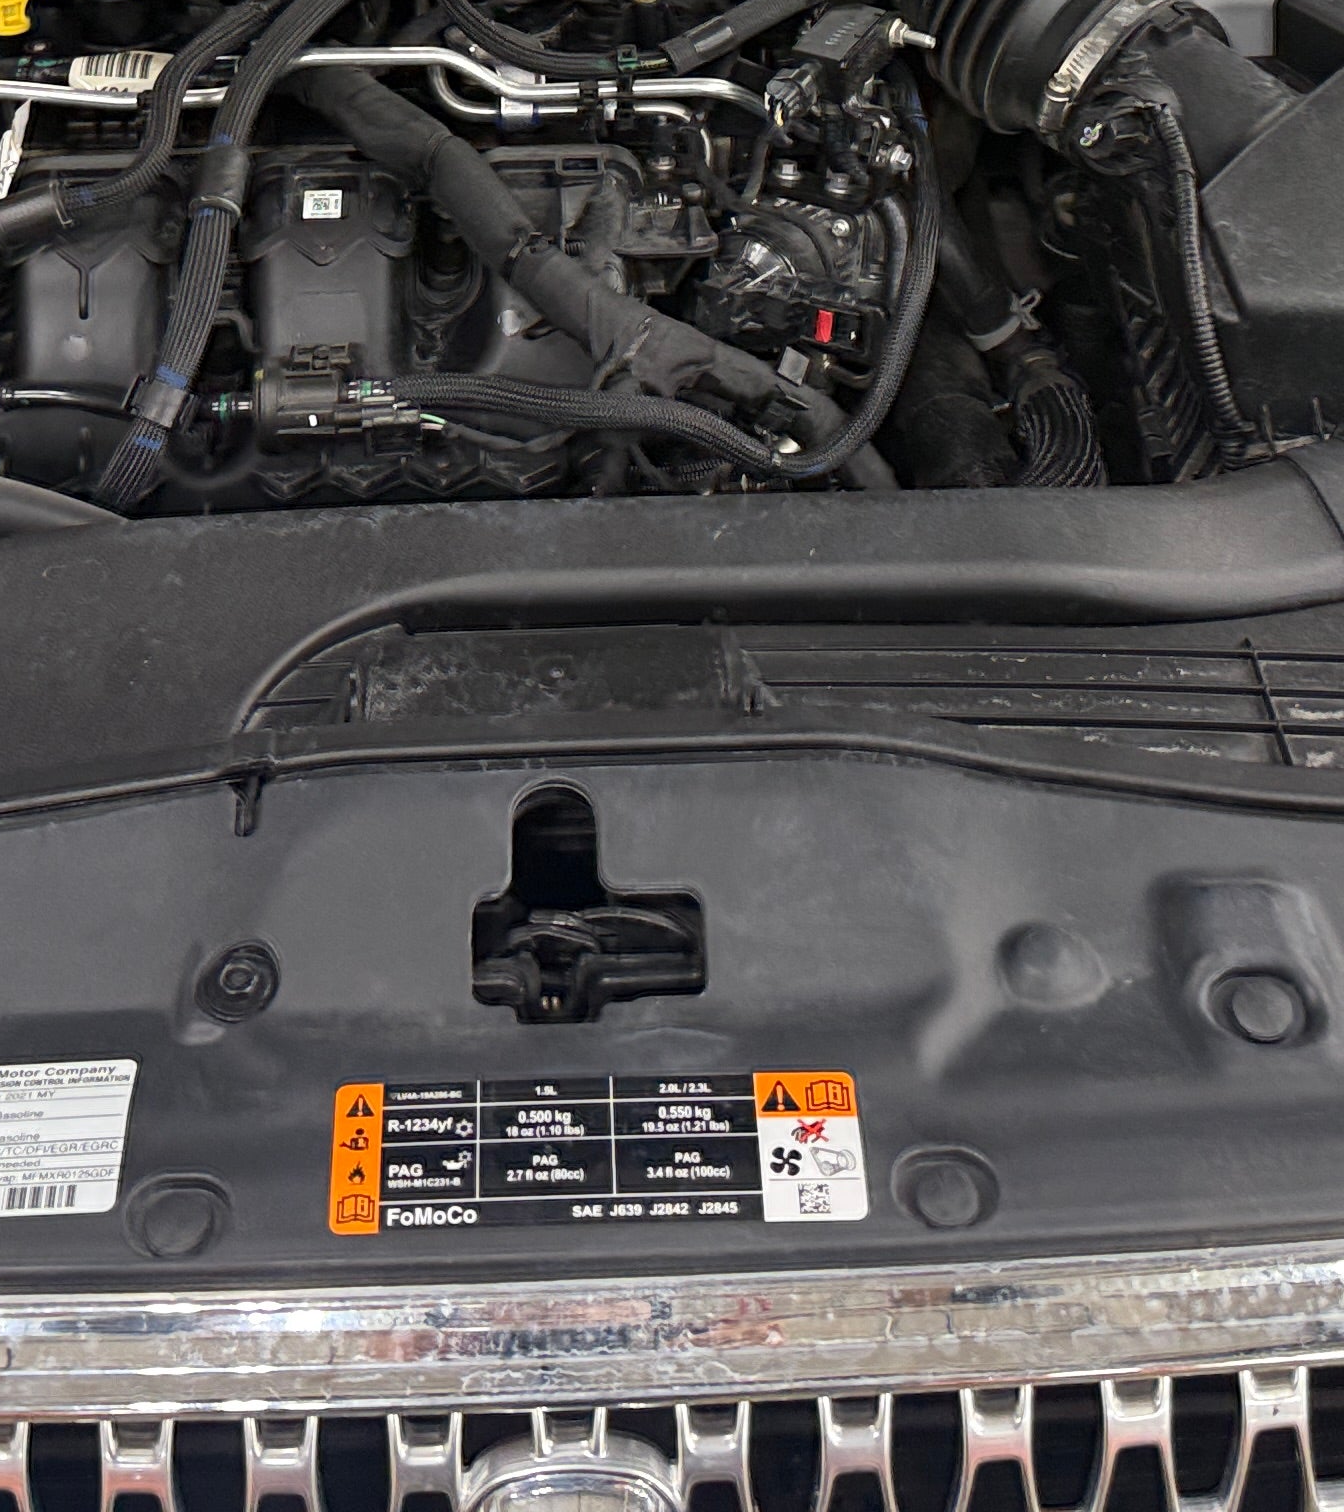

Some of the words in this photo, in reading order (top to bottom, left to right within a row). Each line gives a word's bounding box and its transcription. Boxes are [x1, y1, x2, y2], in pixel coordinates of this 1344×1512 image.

[44, 1066, 117, 1079] Company
[23, 1077, 65, 1087] CONTROL
[67, 1074, 131, 1085] INFORMATION
[37, 1090, 56, 1098] MY
[517, 1110, 552, 1124] 0.500
[554, 1110, 572, 1126] kg
[658, 1105, 692, 1119] 0.550
[694, 1105, 711, 1120] kg
[387, 1117, 454, 1133] R-1234yf
[642, 1122, 664, 1133] 19.5
[666, 1124, 679, 1132] oz
[680, 1121, 705, 1134] (1.21
[705, 1120, 730, 1133] lbs)
[518, 1128, 533, 1137] oz
[532, 1154, 559, 1167] PAG
[674, 1151, 701, 1164] PAG
[388, 1163, 423, 1178] PAG
[506, 1170, 523, 1181] 2.7
[534, 1171, 549, 1180] oz
[646, 1168, 664, 1178] 3.4
[673, 1169, 688, 1178] oz
[689, 1166, 730, 1179] (100cc)
[571, 1204, 603, 1217] SAE
[609, 1203, 643, 1217] J639
[649, 1202, 690, 1216] J2842
[698, 1201, 739, 1215] J2845
[386, 1205, 478, 1227] FoMoCo
